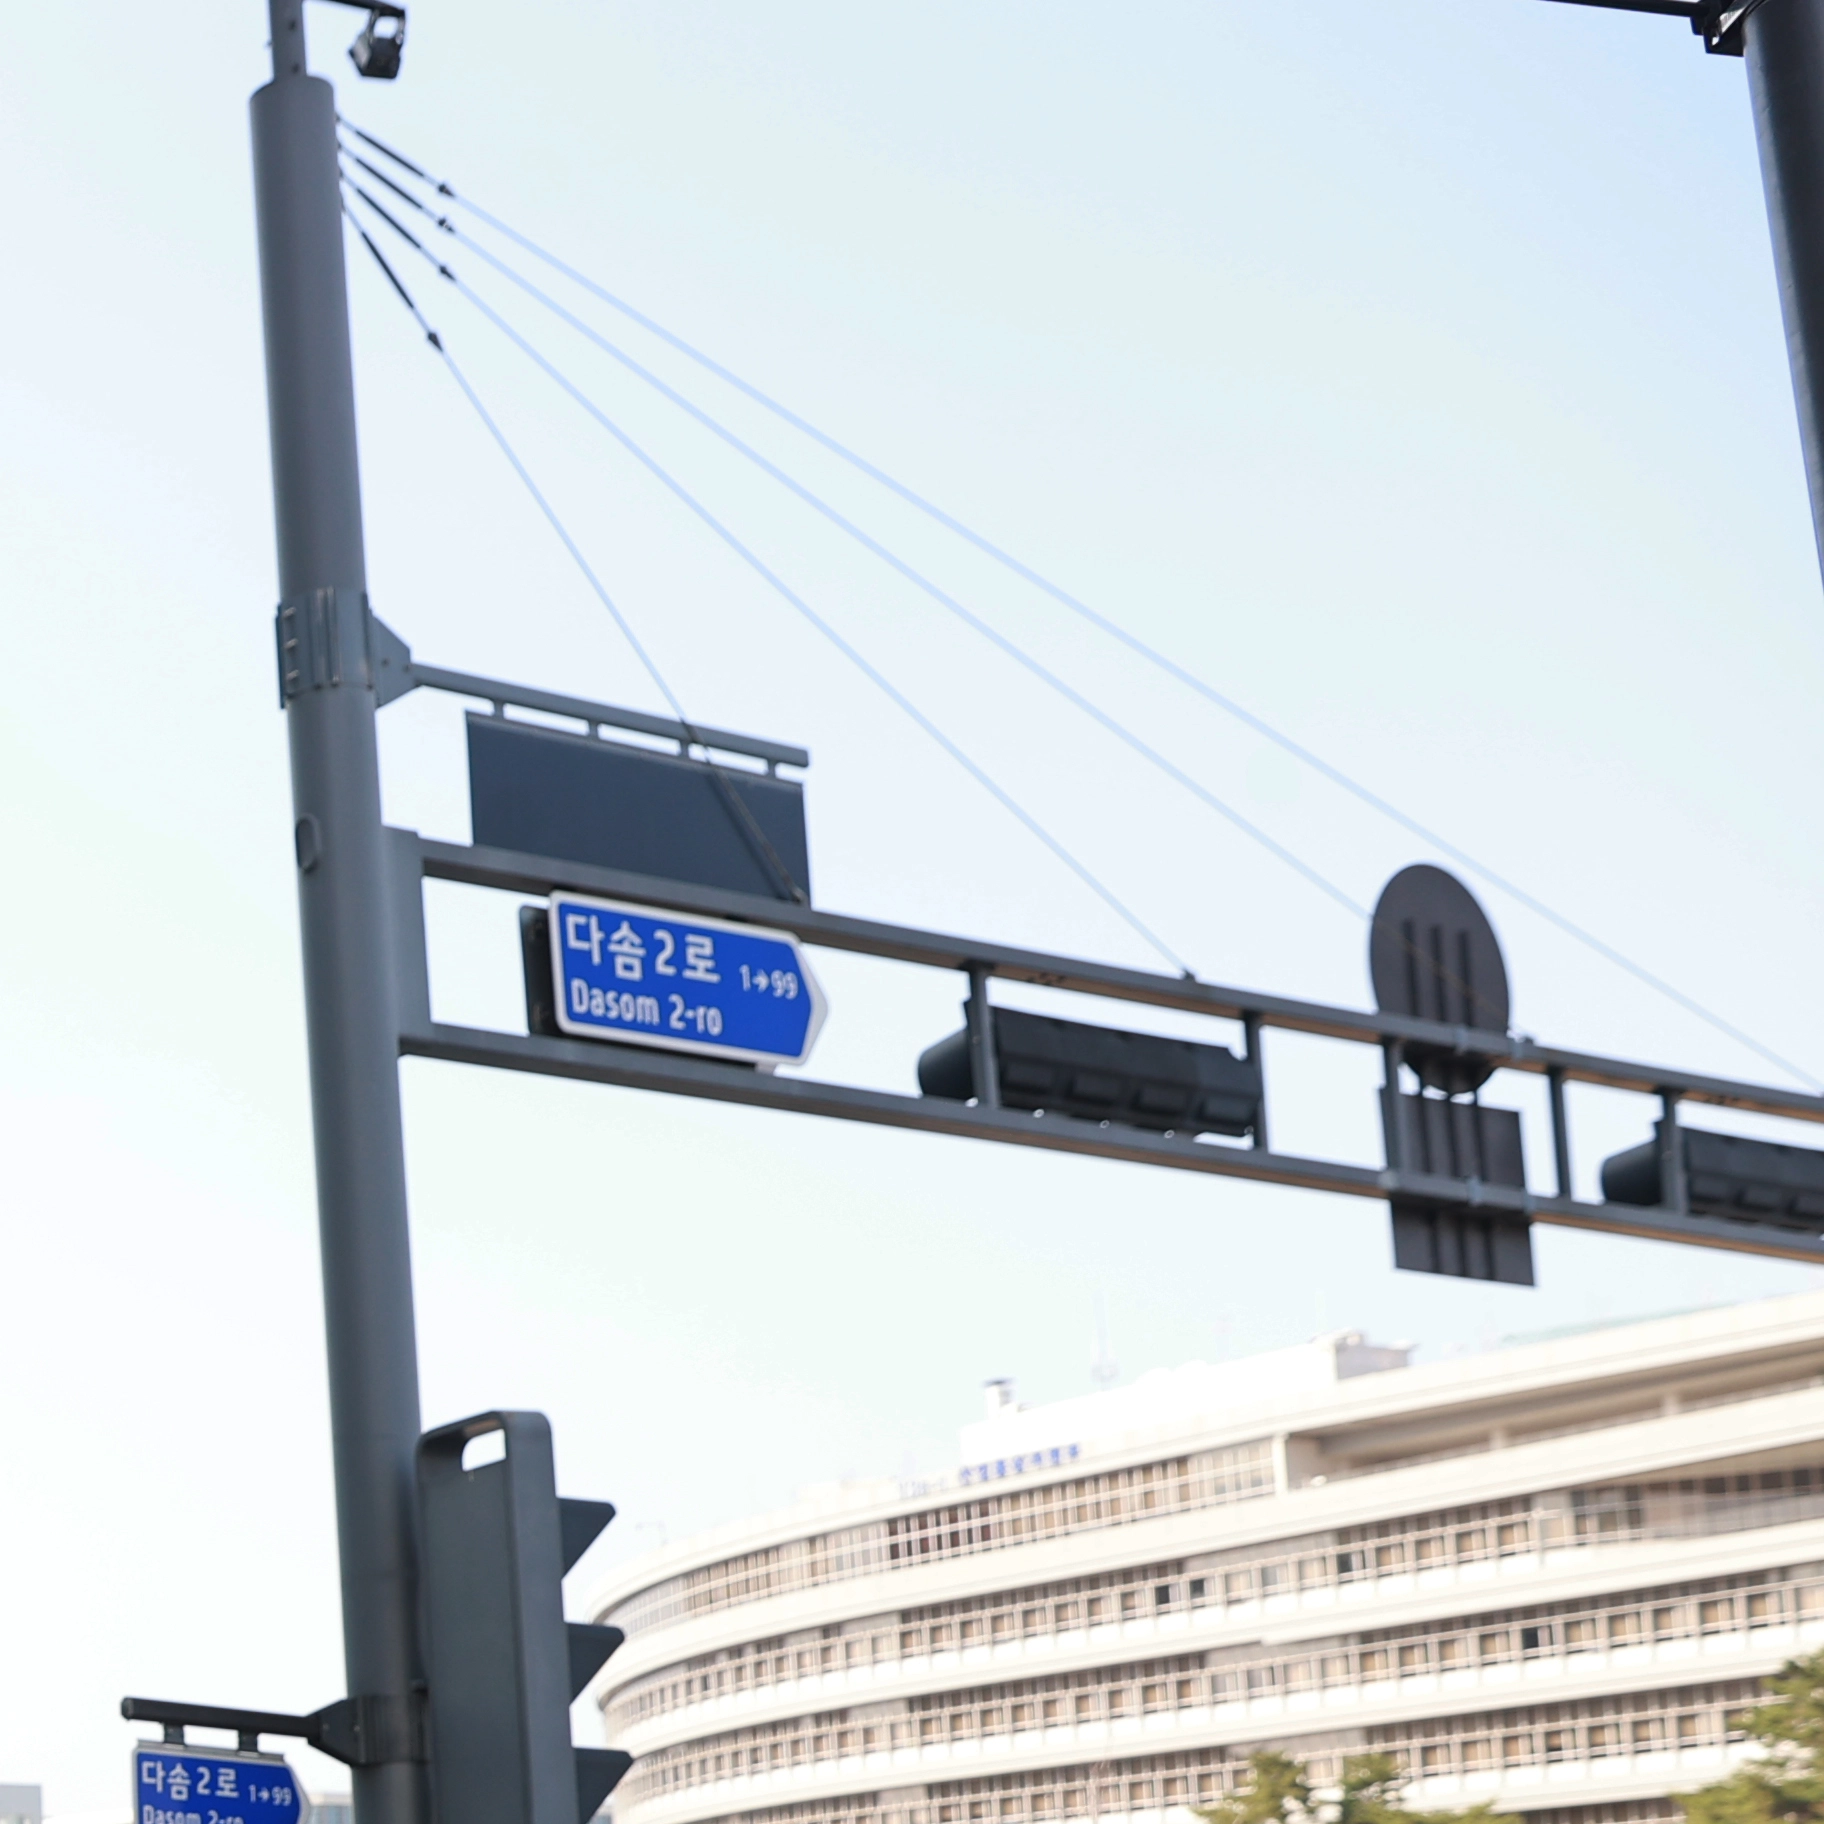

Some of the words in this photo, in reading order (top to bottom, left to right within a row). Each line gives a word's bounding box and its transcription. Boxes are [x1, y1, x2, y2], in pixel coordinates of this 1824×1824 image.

[565, 912, 722, 985] 다솜2로
[570, 979, 660, 1026] Dasom
[669, 994, 723, 1037] 2-ro
[141, 1760, 239, 1801] 다솜2로
